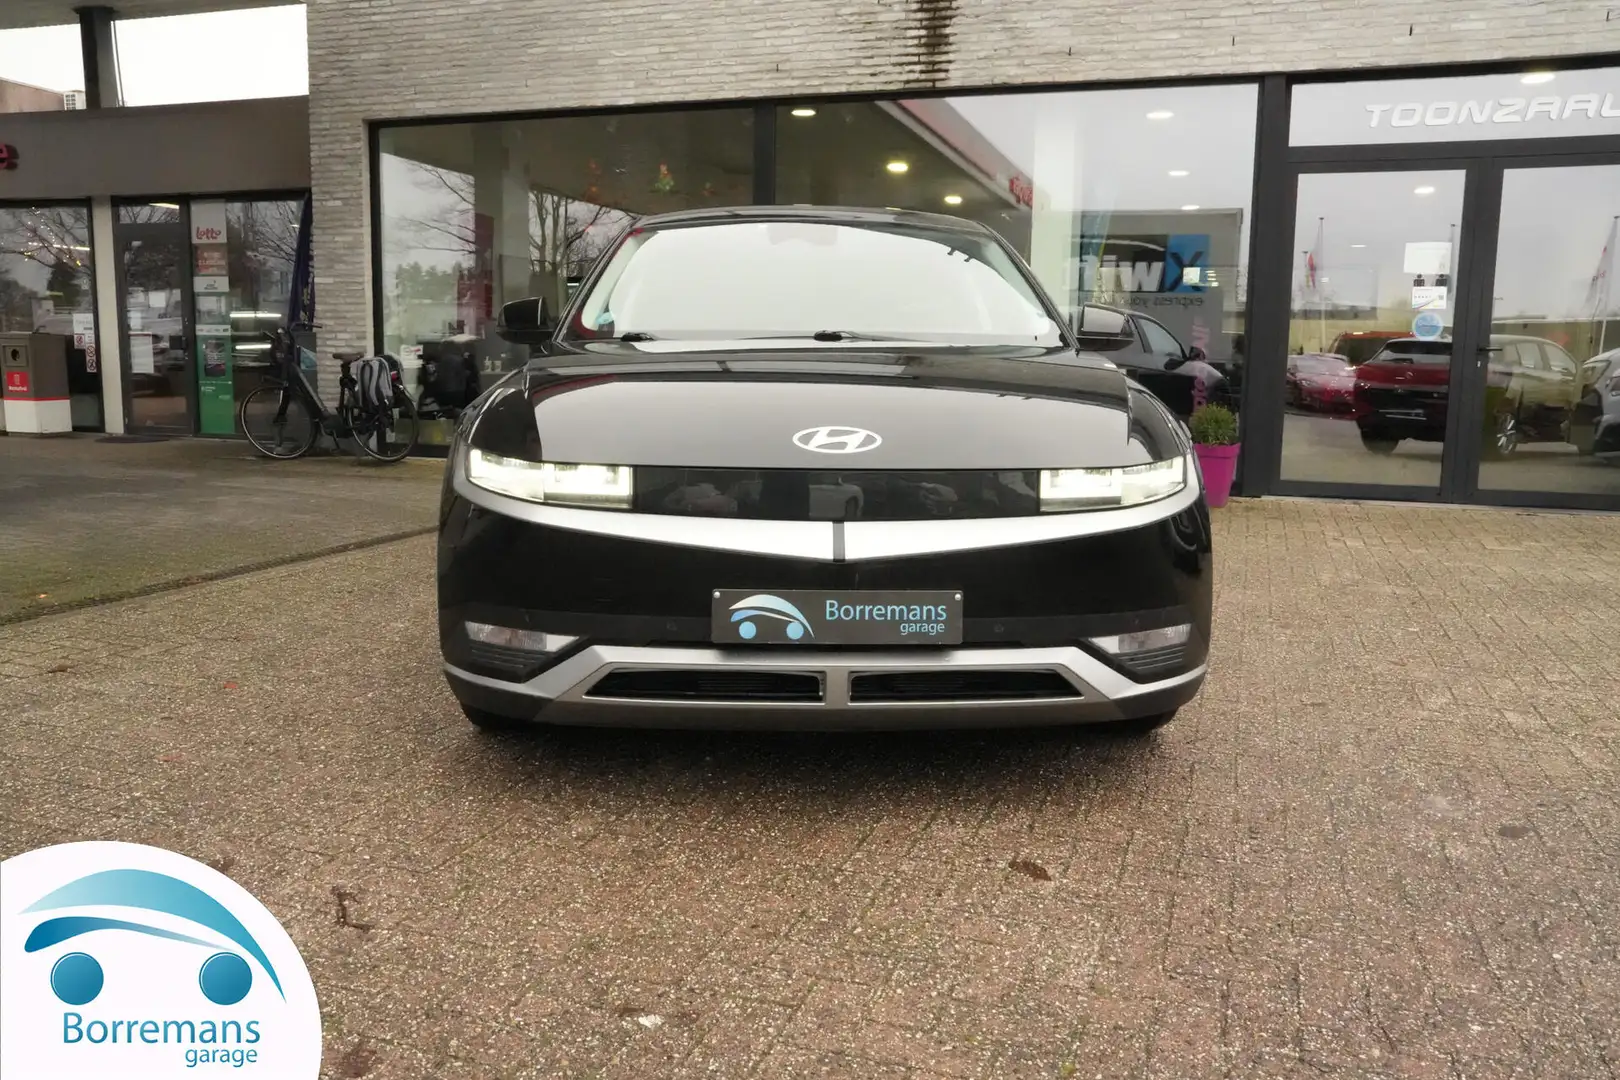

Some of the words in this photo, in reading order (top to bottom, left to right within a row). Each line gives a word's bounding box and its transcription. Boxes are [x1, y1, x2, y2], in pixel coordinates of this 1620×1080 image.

[1365, 92, 1620, 128] TOONZAAL
[825, 600, 947, 621] Borremans
[900, 622, 945, 635] garage
